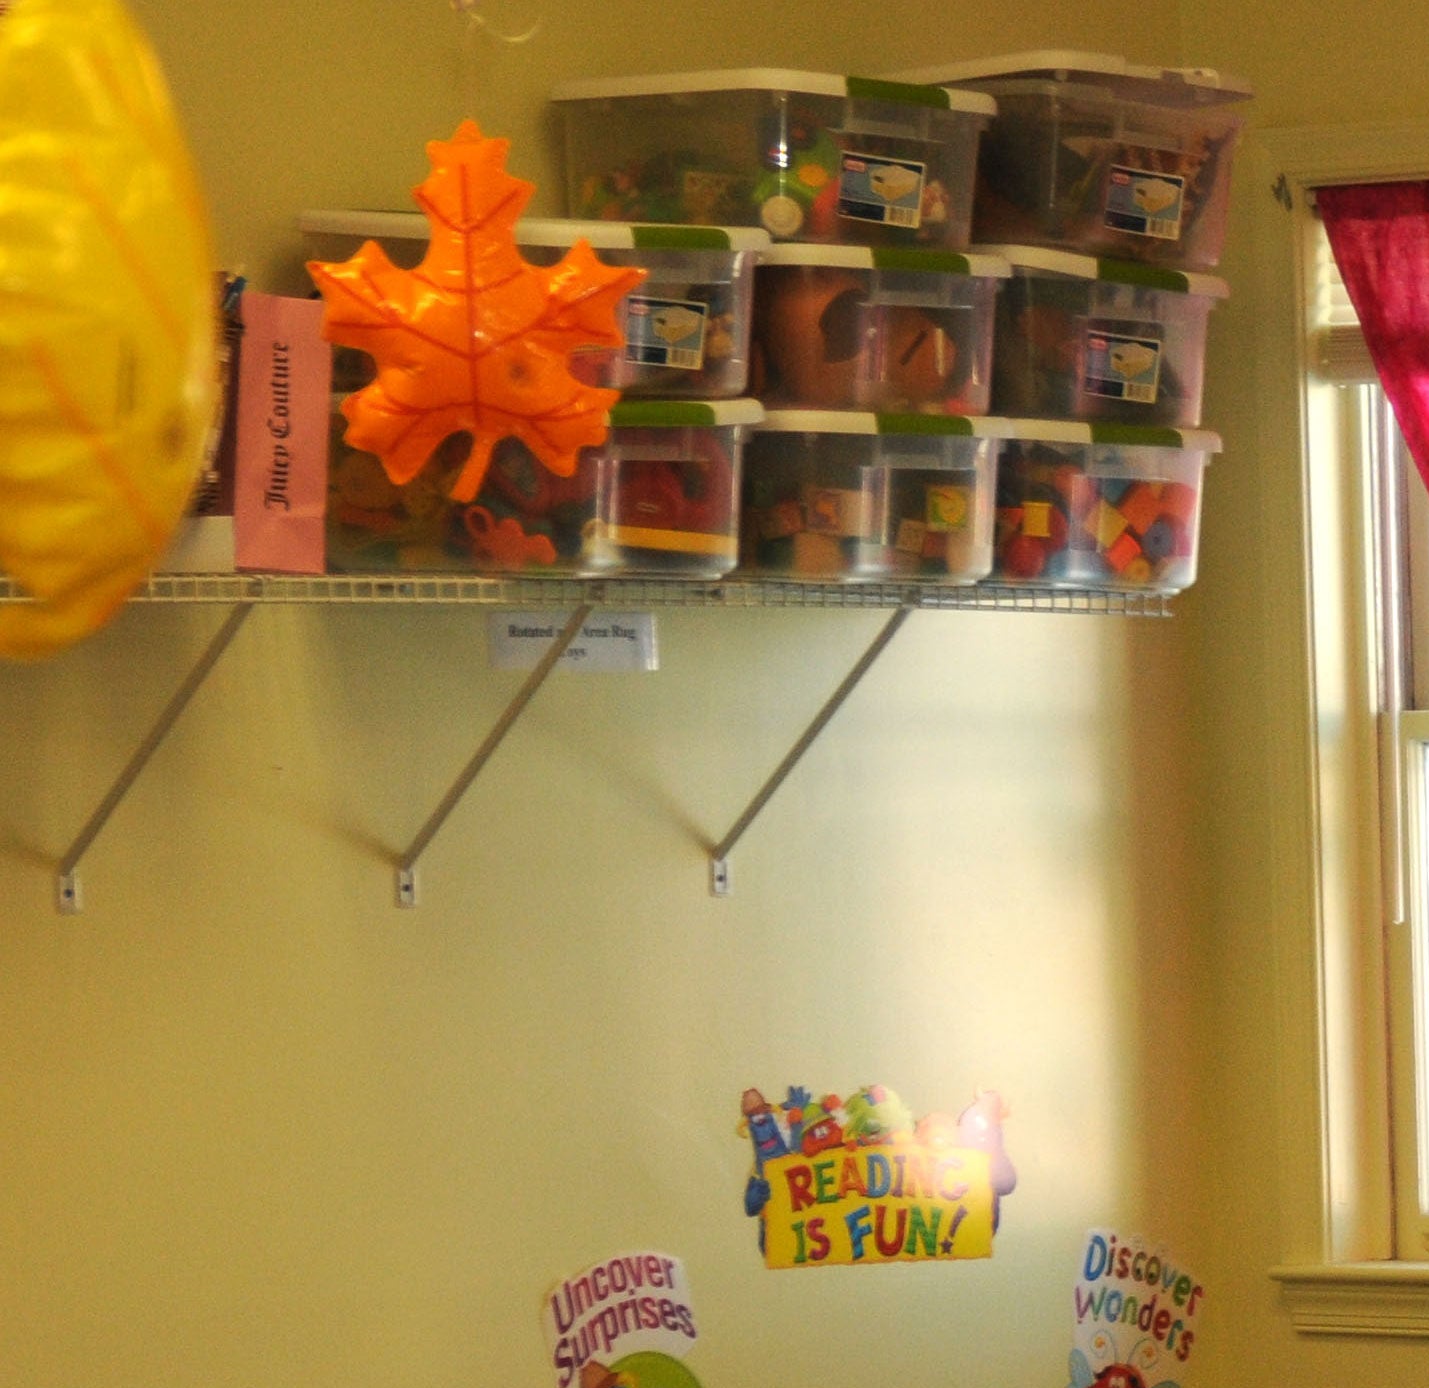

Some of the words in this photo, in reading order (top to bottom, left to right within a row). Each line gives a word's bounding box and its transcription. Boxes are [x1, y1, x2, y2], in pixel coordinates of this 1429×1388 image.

[266, 342, 290, 439] Couture
[263, 445, 290, 512] Juicy
[784, 1153, 969, 1213] READING
[791, 1218, 832, 1263] IS
[845, 1204, 968, 1261] FUN!
[550, 1254, 675, 1335] Uncover
[1083, 1233, 1206, 1317] Discover
[1074, 1285, 1195, 1363] Wonders
